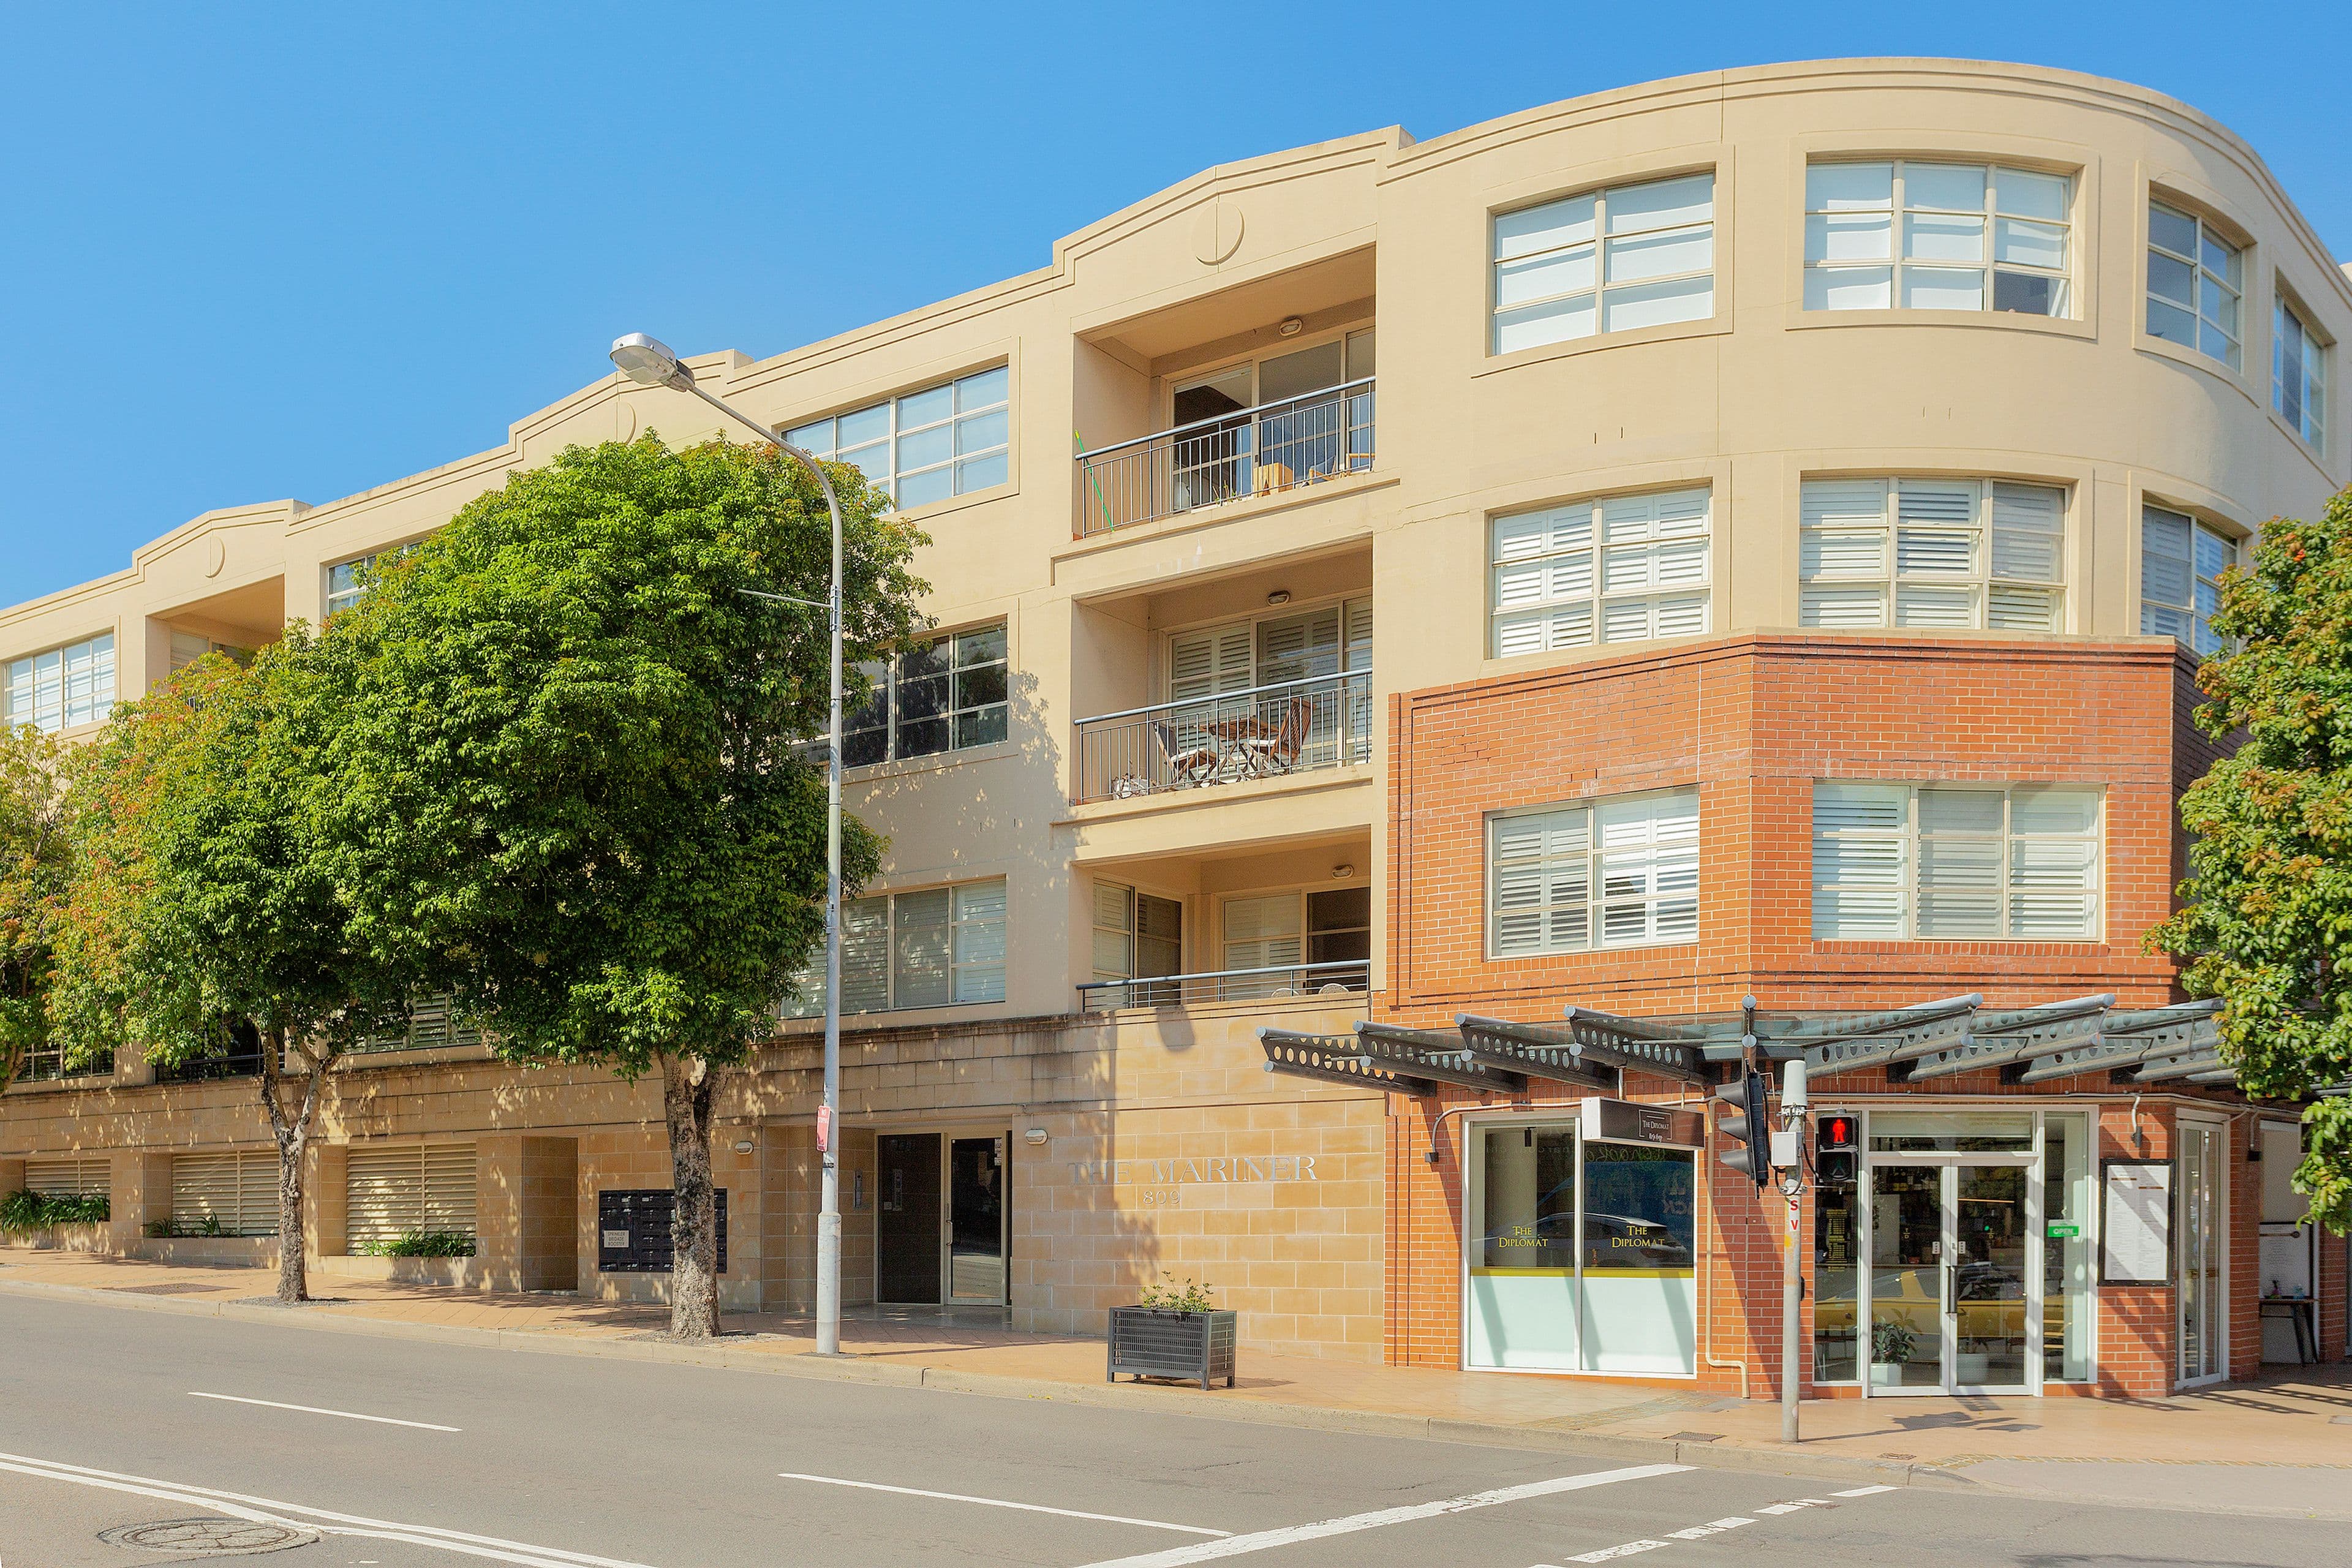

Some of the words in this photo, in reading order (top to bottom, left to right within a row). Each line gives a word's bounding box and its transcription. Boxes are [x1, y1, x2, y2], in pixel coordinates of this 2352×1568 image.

[1067, 1161, 1133, 1185] THE
[1151, 1156, 1318, 1184] MARINER
[1143, 1191, 1181, 1205] 809
[1512, 1226, 1532, 1236] THE
[1626, 1226, 1648, 1236] THE
[1499, 1237, 1548, 1248] DIPLOMAT
[1611, 1237, 1665, 1248] DIPLOMAT
